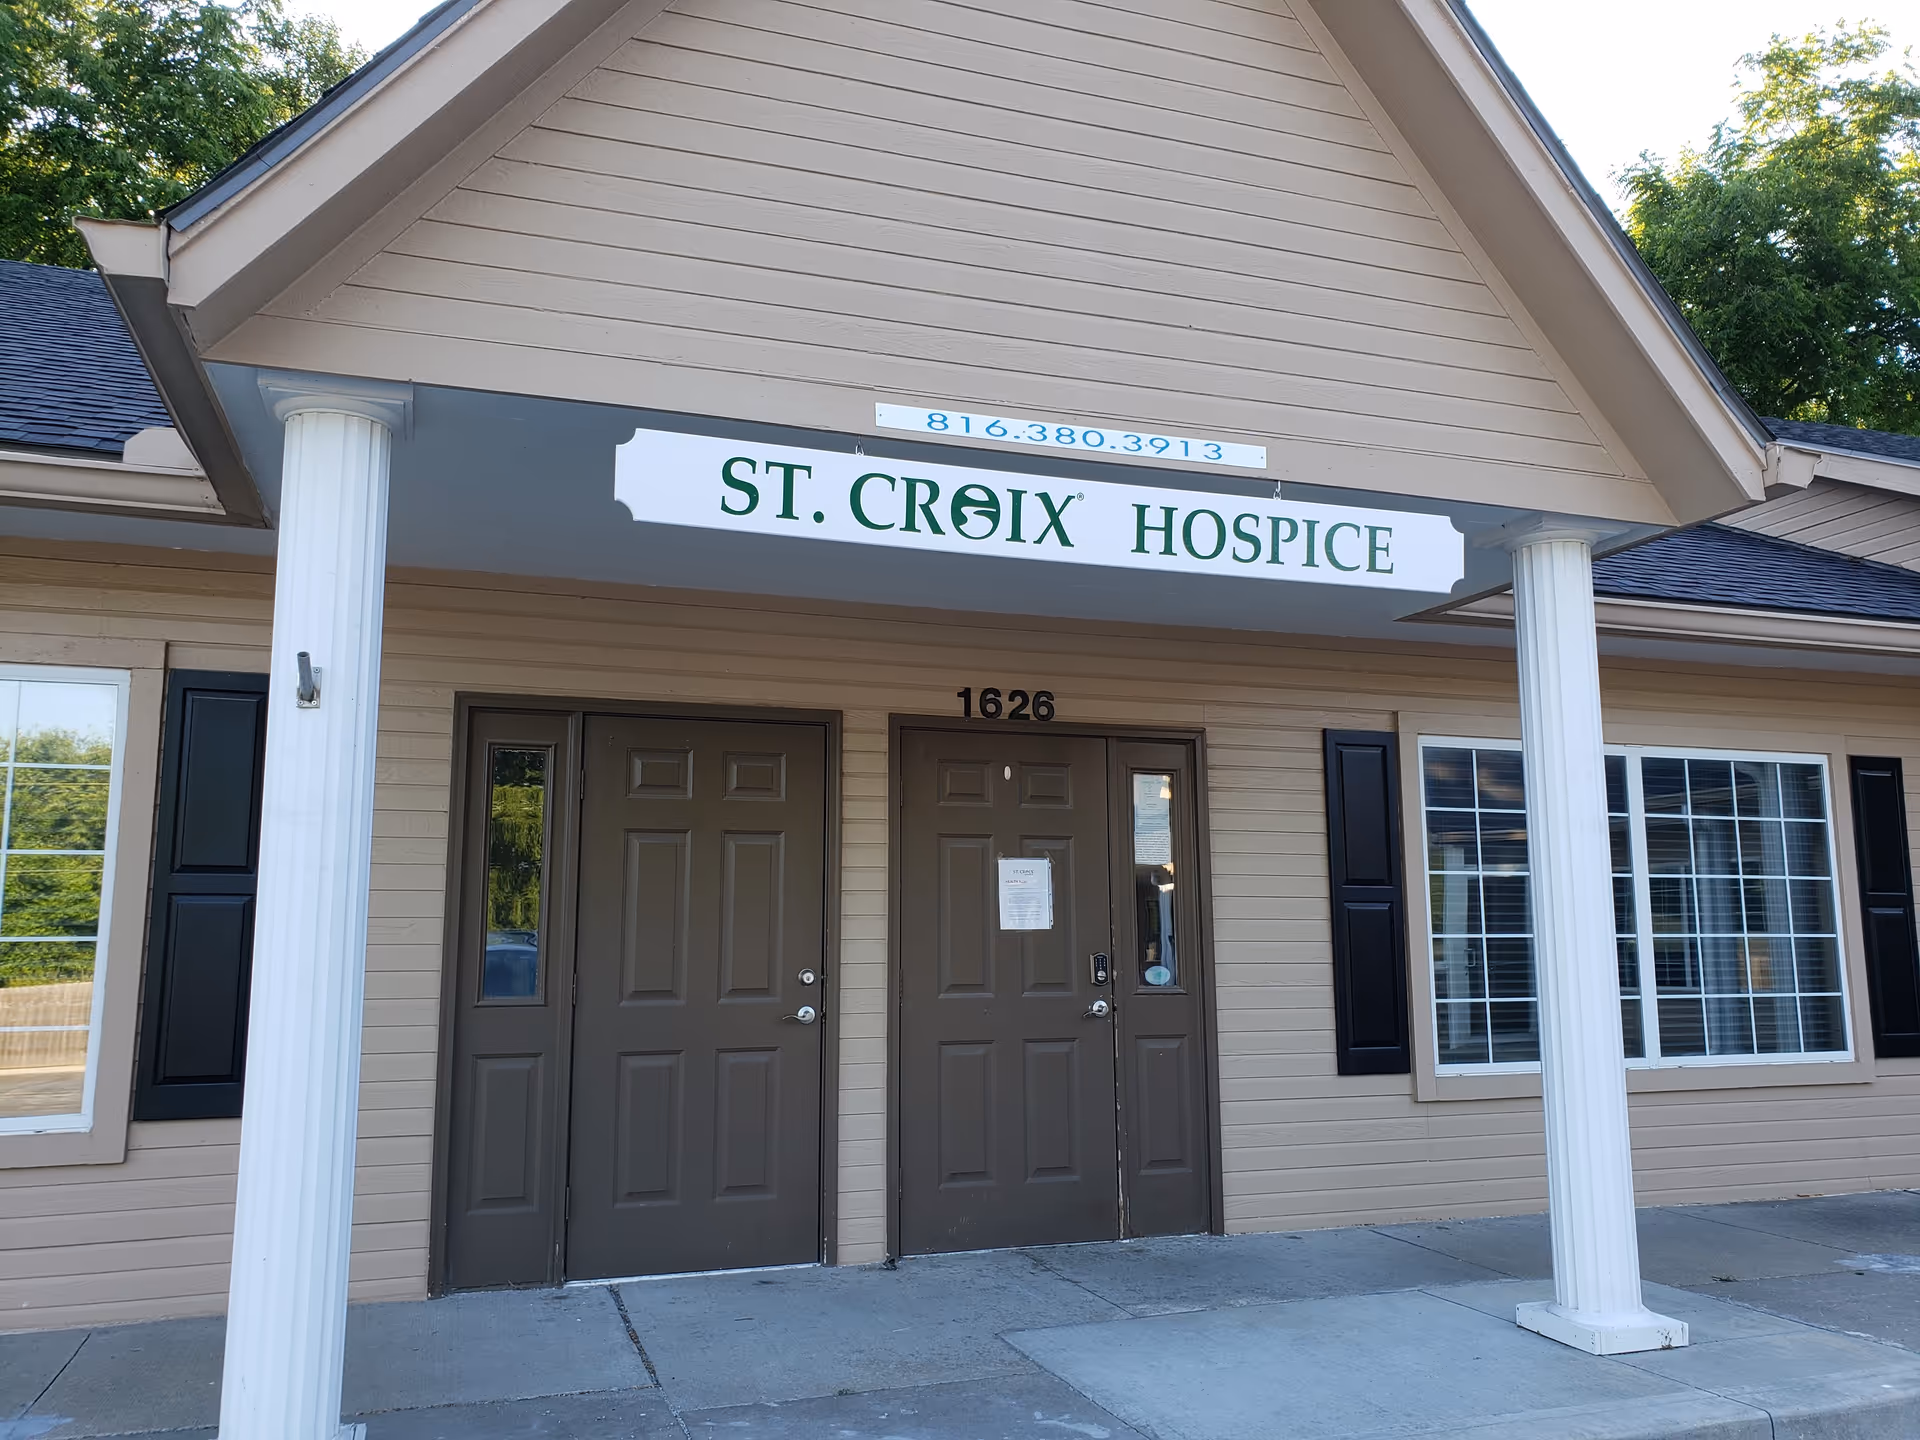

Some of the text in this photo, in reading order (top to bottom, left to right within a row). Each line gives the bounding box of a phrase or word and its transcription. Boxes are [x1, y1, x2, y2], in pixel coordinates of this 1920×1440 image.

[926, 412, 1223, 461] 816.380.3913
[721, 457, 824, 524] ST.
[1131, 504, 1393, 574] HOSPICE
[957, 686, 1055, 722] 1626
